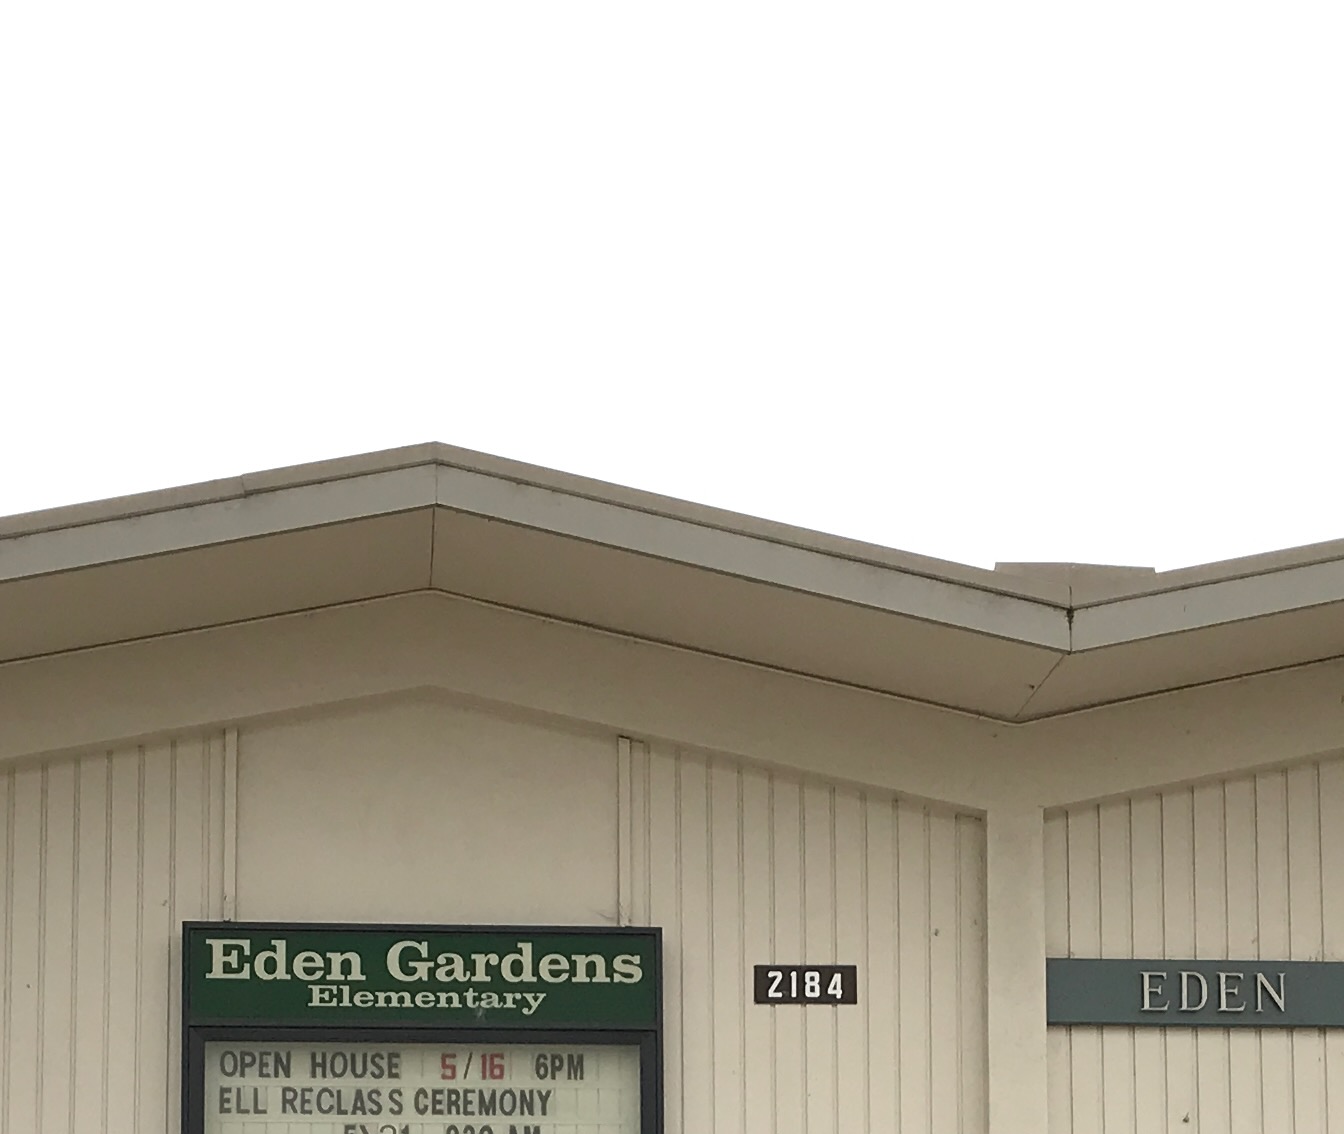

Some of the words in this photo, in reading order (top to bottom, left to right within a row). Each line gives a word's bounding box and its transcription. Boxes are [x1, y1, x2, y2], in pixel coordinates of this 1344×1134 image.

[205, 939, 366, 980] Eden
[386, 940, 643, 984] Gardens
[767, 970, 843, 999] 2184
[1139, 971, 1287, 1013] EDEN
[308, 985, 547, 1014] Elementary
[219, 1050, 291, 1079] OPEN
[310, 1052, 401, 1079] HOUSE
[440, 1053, 505, 1080] 5/16
[535, 1053, 584, 1080] 6PM
[219, 1088, 267, 1114] ELL
[281, 1088, 404, 1116] RECLASS
[414, 1089, 552, 1117] CEREMONY
